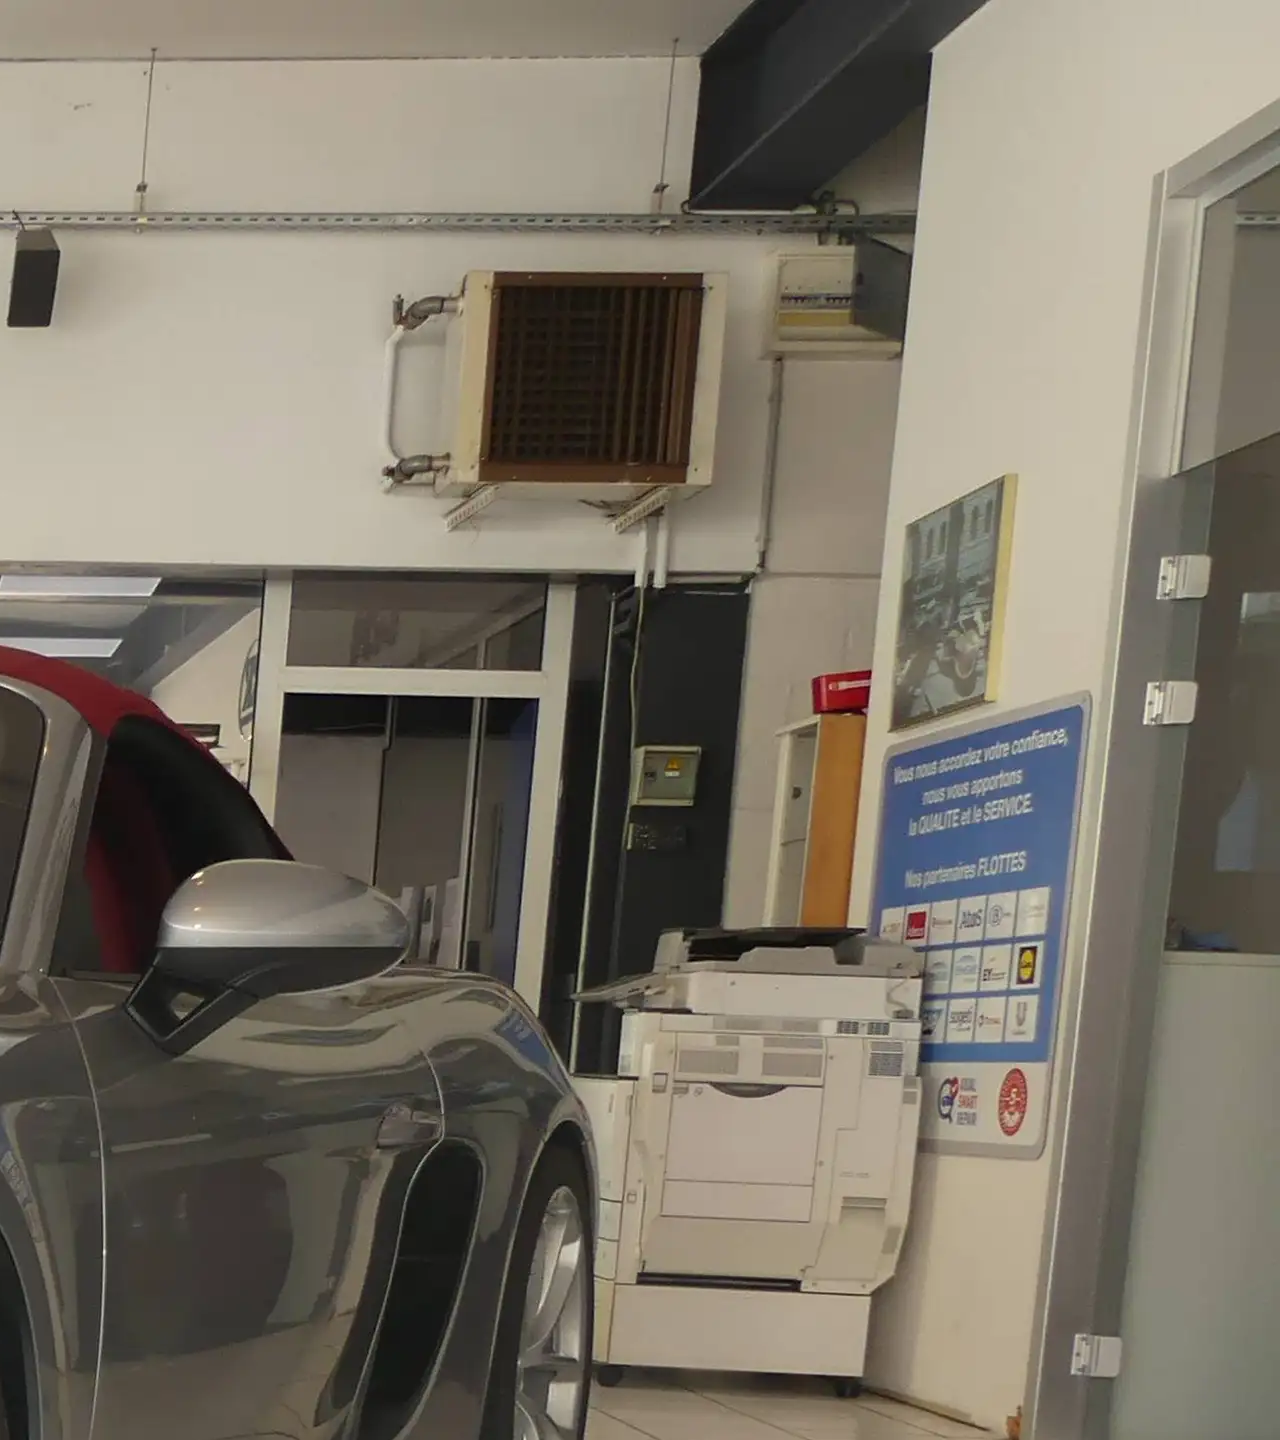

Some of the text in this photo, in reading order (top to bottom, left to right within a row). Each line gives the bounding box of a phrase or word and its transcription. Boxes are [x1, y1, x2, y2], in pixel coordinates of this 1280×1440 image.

[894, 765, 914, 785] Vous
[915, 760, 937, 779] nous
[939, 748, 982, 773] accordez
[983, 740, 1009, 762] votre
[922, 769, 1023, 806] nous vous apportons
[908, 817, 917, 837] la
[918, 808, 960, 834] QUALITE
[960, 809, 971, 825] et
[972, 804, 982, 823] le
[904, 851, 1027, 889] Nos partenaires FLOTTES
